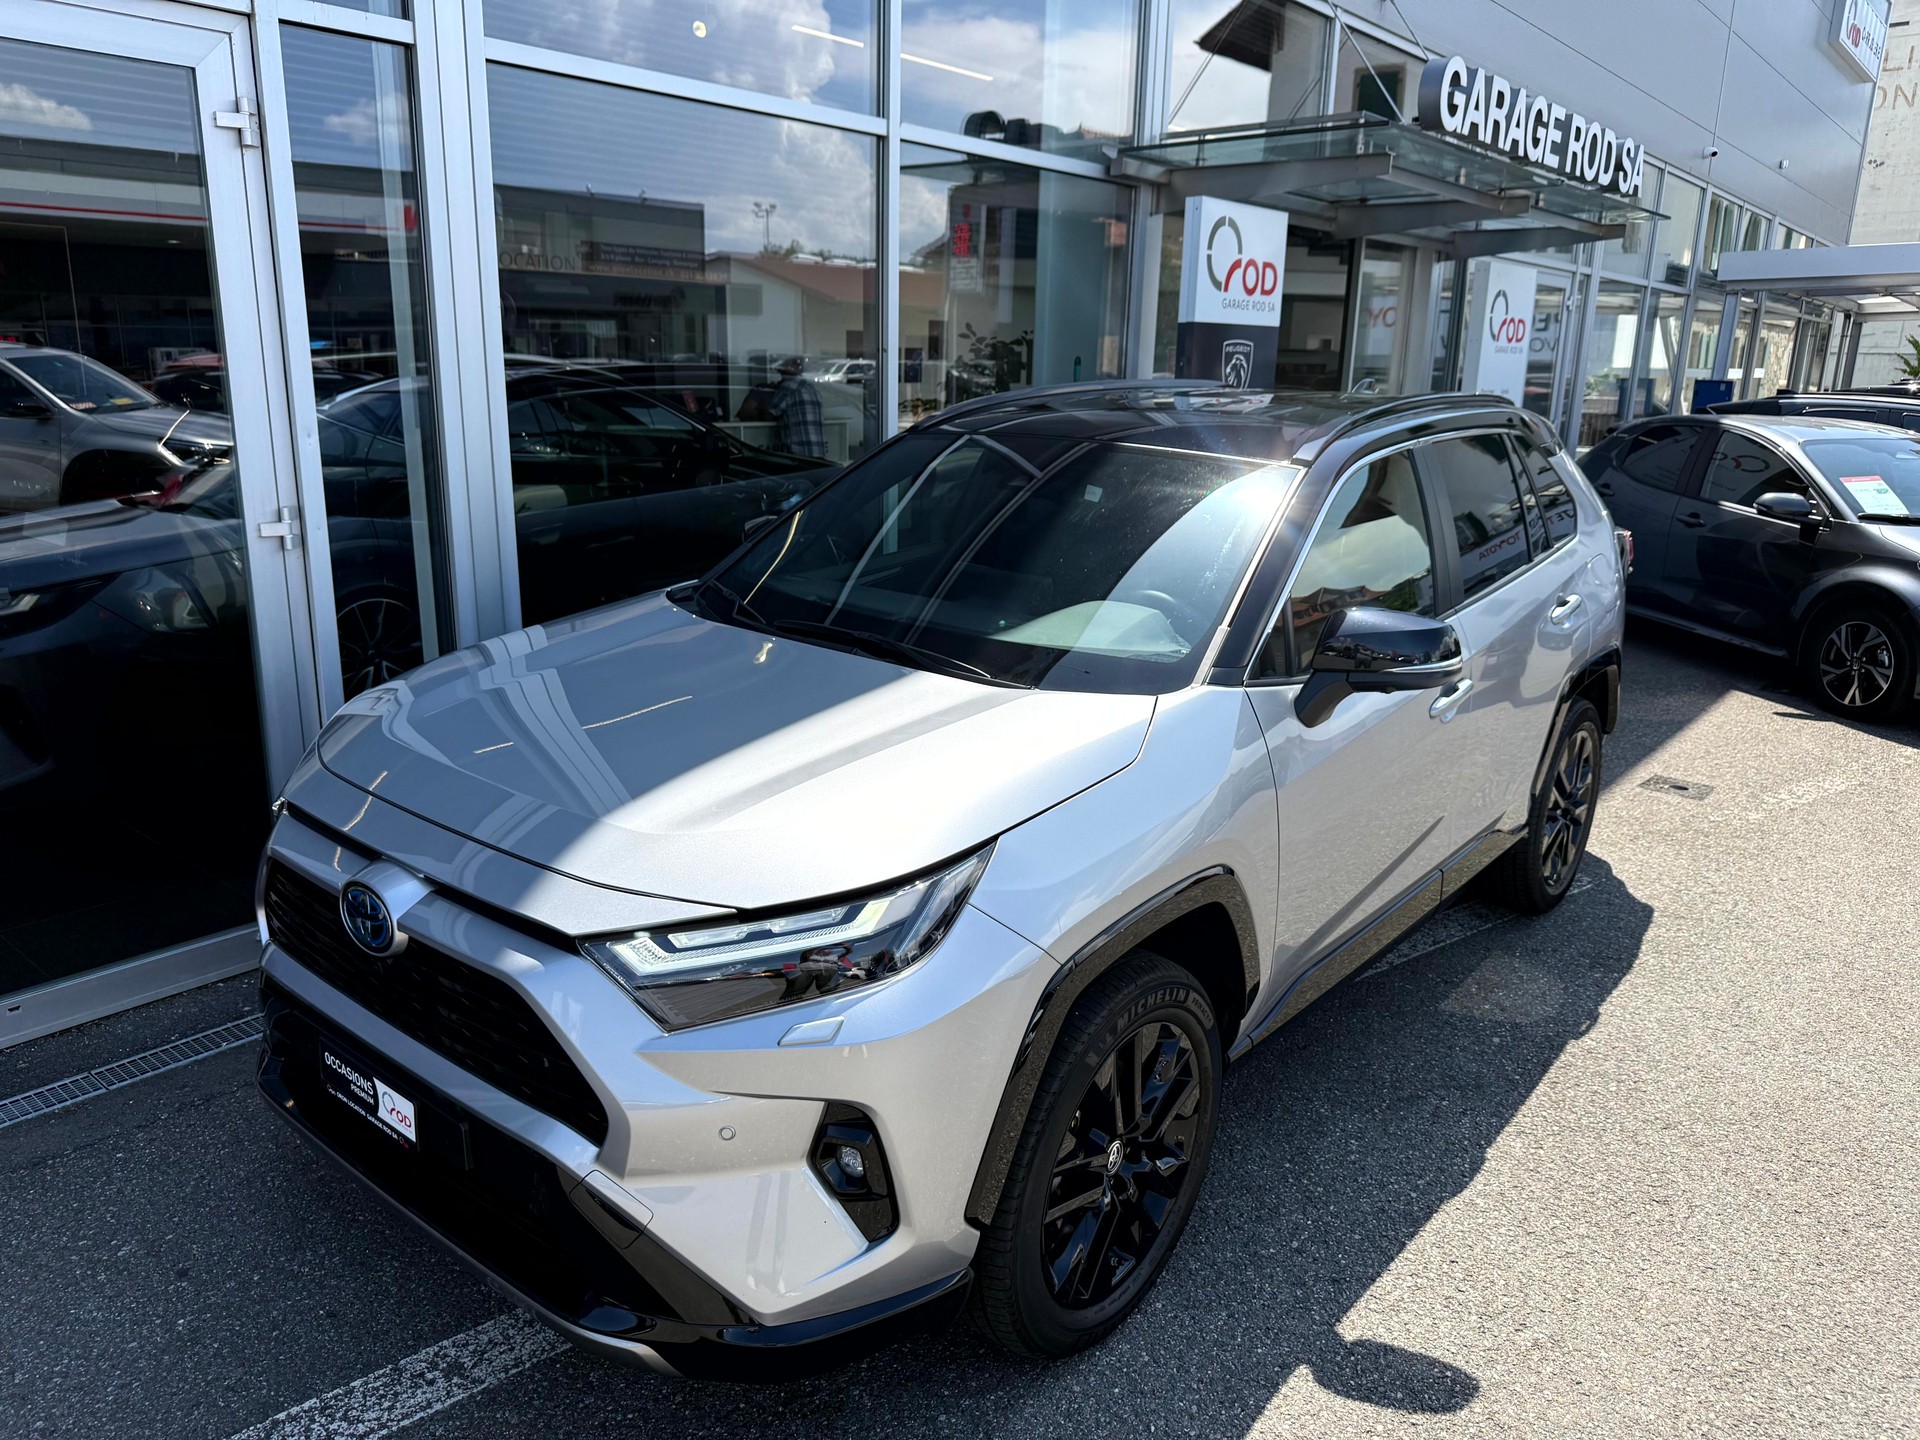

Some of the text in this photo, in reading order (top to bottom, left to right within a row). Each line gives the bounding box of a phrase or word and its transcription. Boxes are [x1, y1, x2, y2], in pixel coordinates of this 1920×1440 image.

[1440, 55, 1645, 198] GARAGE ROD SA
[499, 251, 575, 271] OCATION
[1221, 298, 1275, 312] GARAGE ROD SA
[1225, 345, 1250, 353] PEUGEOT
[1117, 987, 1187, 1032] MICHELIN
[324, 1051, 374, 1095] OCCASIONS
[350, 1083, 375, 1106] PREMIUM
